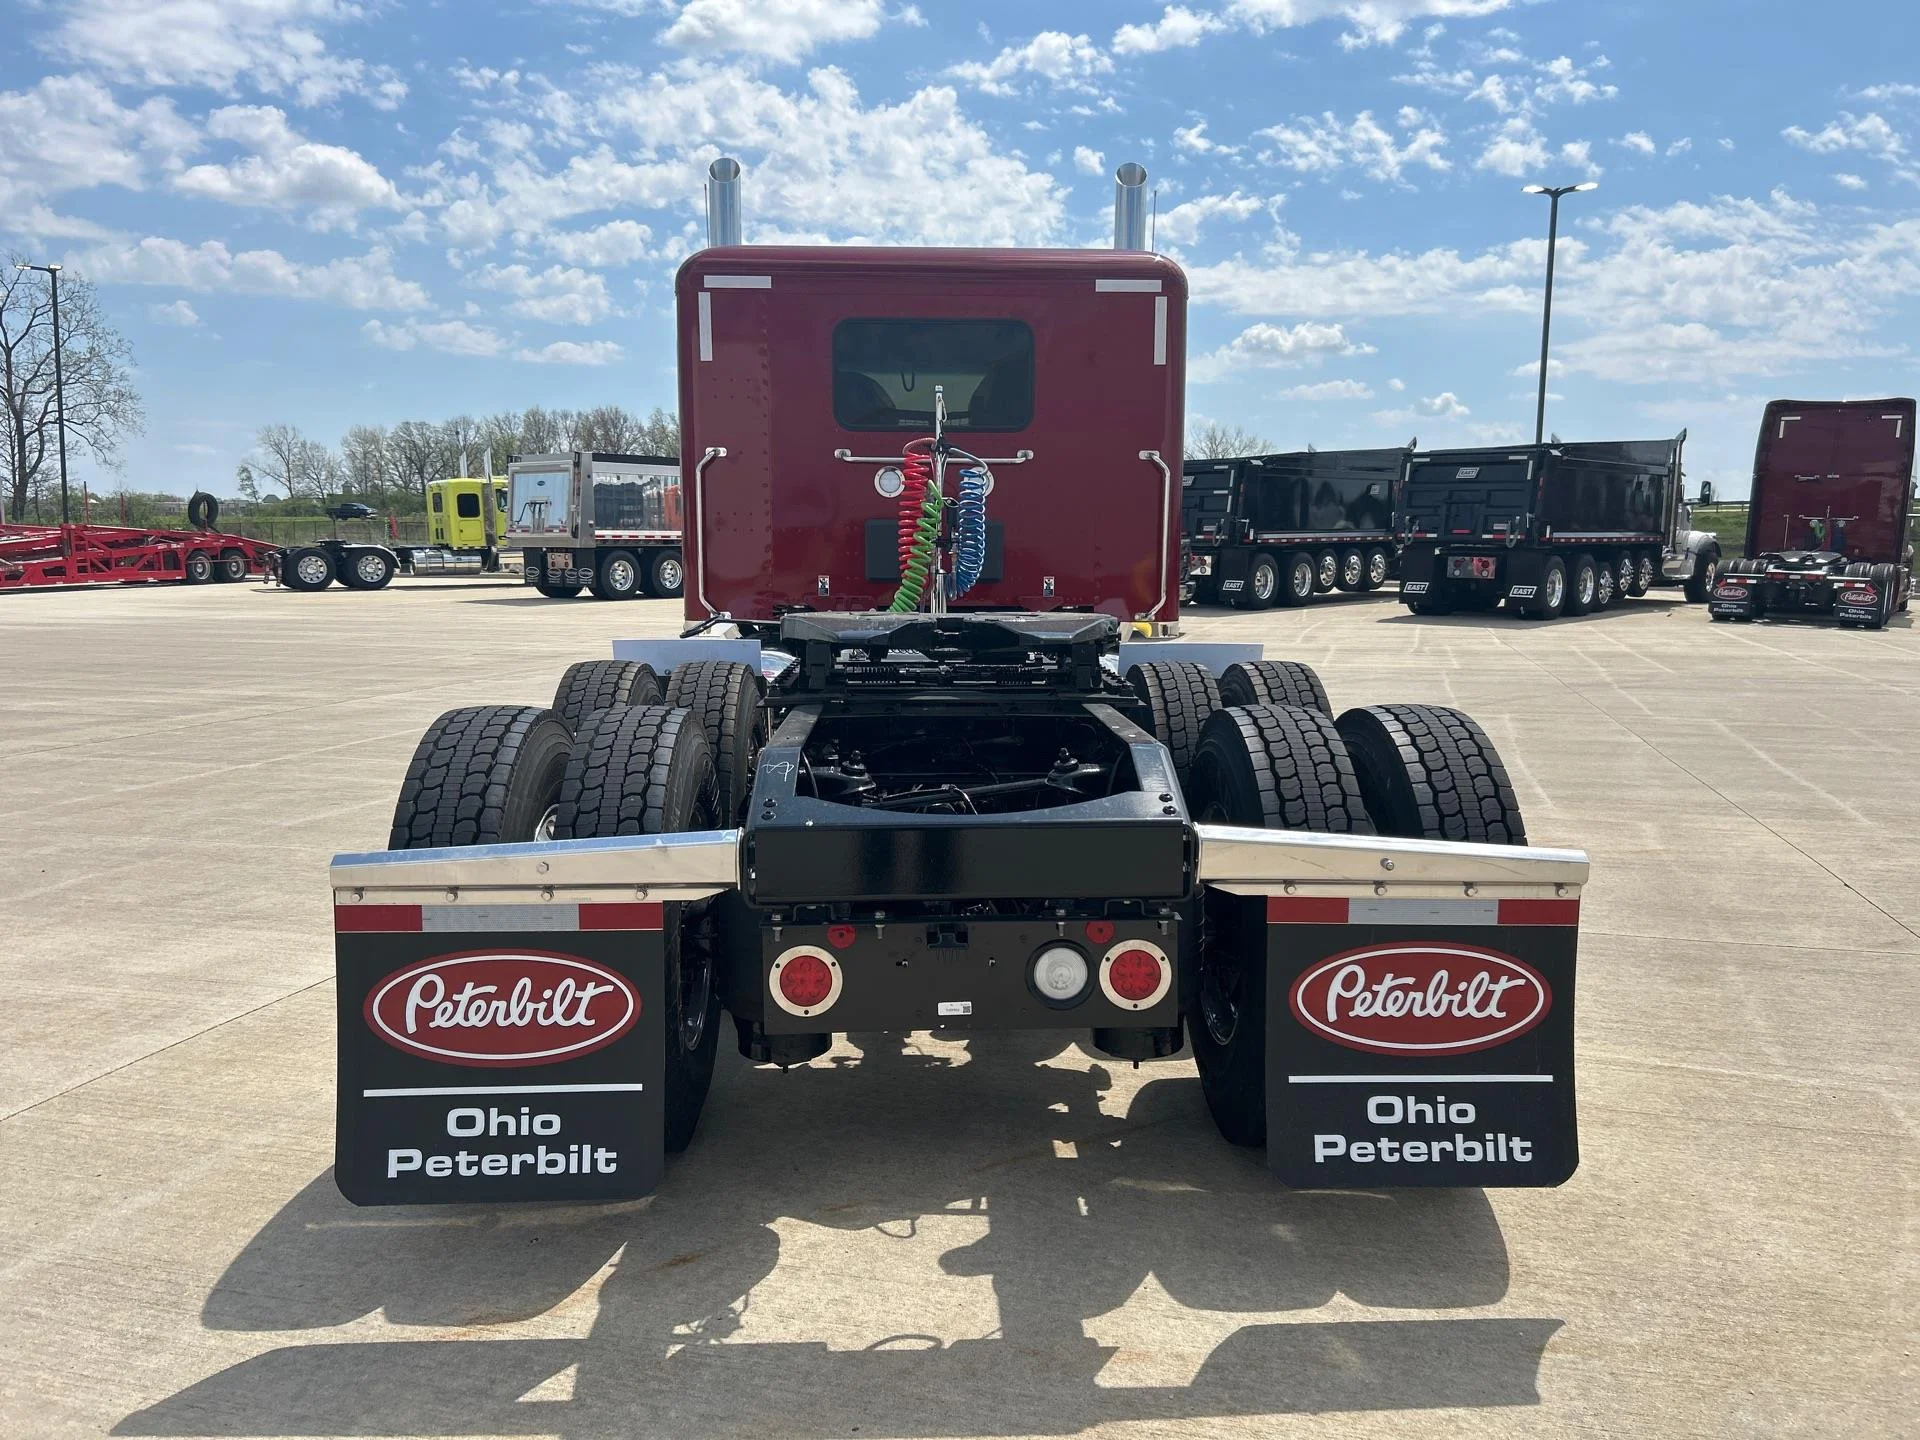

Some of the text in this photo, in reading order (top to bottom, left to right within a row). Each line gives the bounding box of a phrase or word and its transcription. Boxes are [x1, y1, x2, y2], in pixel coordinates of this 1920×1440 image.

[405, 973, 614, 1035] Peterbilt
[1326, 963, 1528, 1023] Peterbilt
[446, 1106, 562, 1138] Ohio
[1366, 1095, 1476, 1125] Ohio
[386, 1144, 618, 1179] Peterbilt
[1313, 1133, 1534, 1163] Peterbilt
